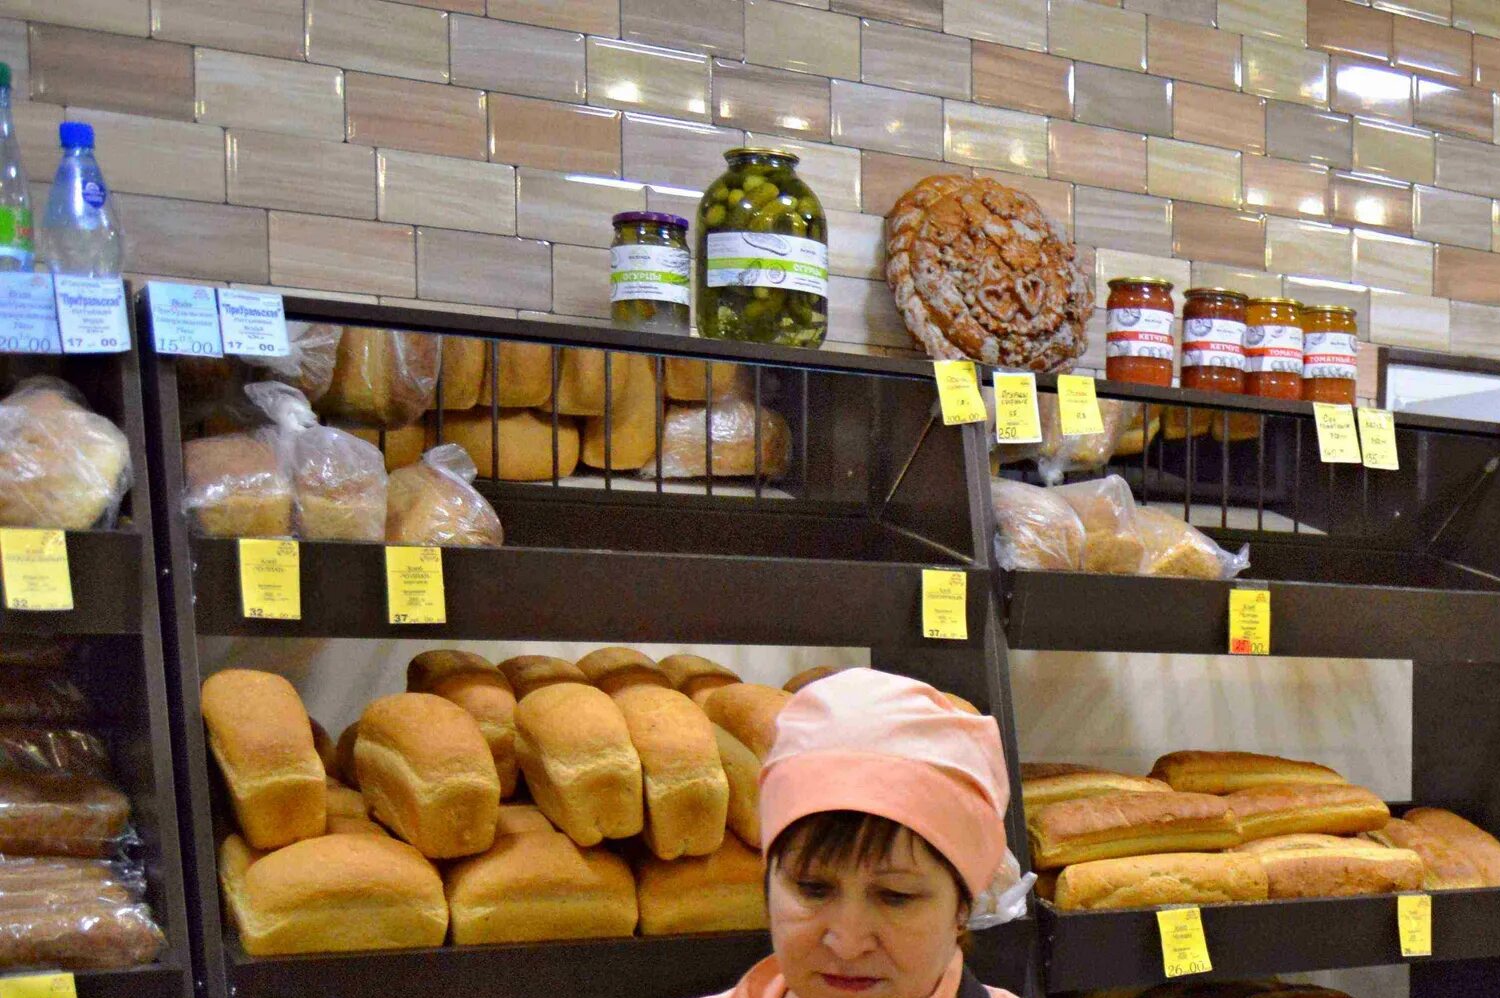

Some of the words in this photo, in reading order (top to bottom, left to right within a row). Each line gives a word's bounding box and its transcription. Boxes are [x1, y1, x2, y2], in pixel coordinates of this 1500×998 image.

[68, 337, 83, 347] 17
[101, 337, 117, 347] 00
[1138, 332, 1168, 344] КЕТЧУП
[158, 338, 178, 352] 15
[192, 341, 213, 354] 00
[227, 341, 243, 350] 17
[259, 342, 275, 351] 00
[1209, 341, 1241, 353] КЕТЧУП
[999, 427, 1017, 439] 250
[249, 608, 263, 617] 32
[394, 613, 408, 622] 37
[929, 629, 940, 637] 37
[1168, 963, 1183, 976] 26
